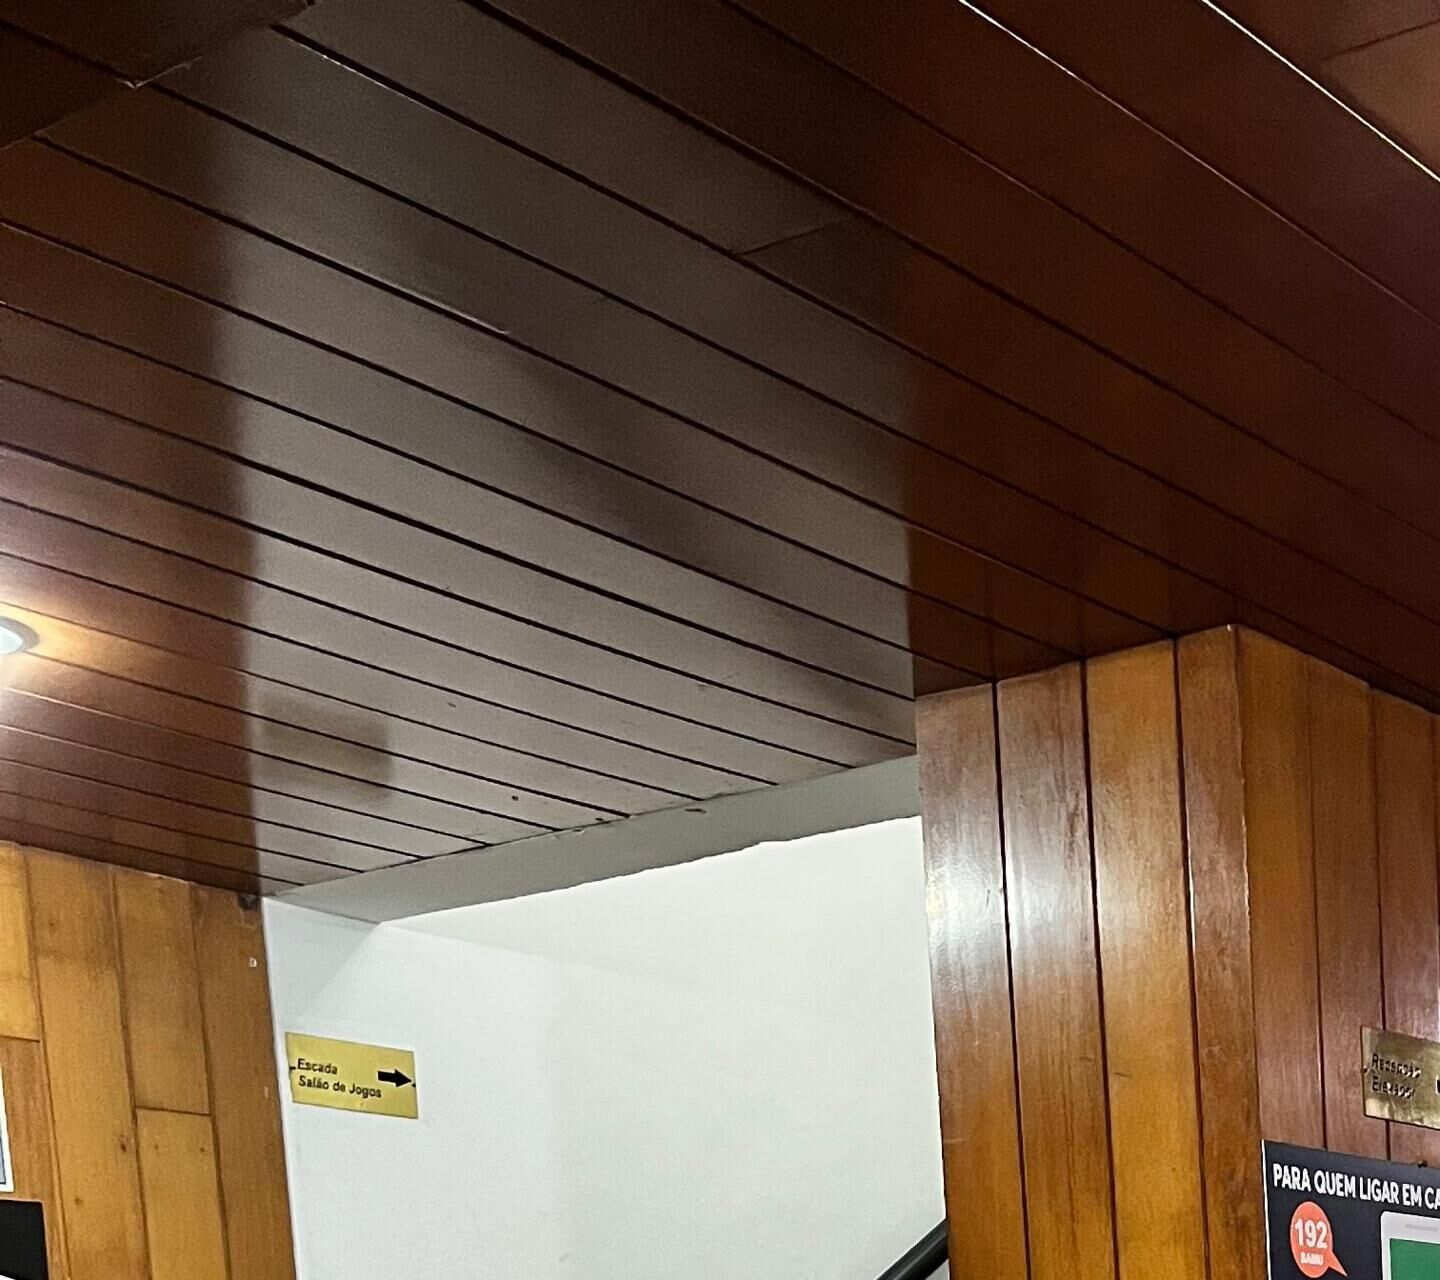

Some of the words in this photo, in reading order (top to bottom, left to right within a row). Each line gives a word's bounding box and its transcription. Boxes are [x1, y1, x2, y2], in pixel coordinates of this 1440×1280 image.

[297, 1058, 338, 1074] Escada
[298, 1075, 329, 1089] Salão
[333, 1081, 346, 1092] de
[349, 1084, 382, 1098] Jogos
[1273, 1163, 1311, 1192] PARA
[1314, 1170, 1356, 1198] QUEM
[1359, 1176, 1400, 1204] LIGAR
[1402, 1183, 1422, 1207] EM
[1294, 1218, 1328, 1249] 192
